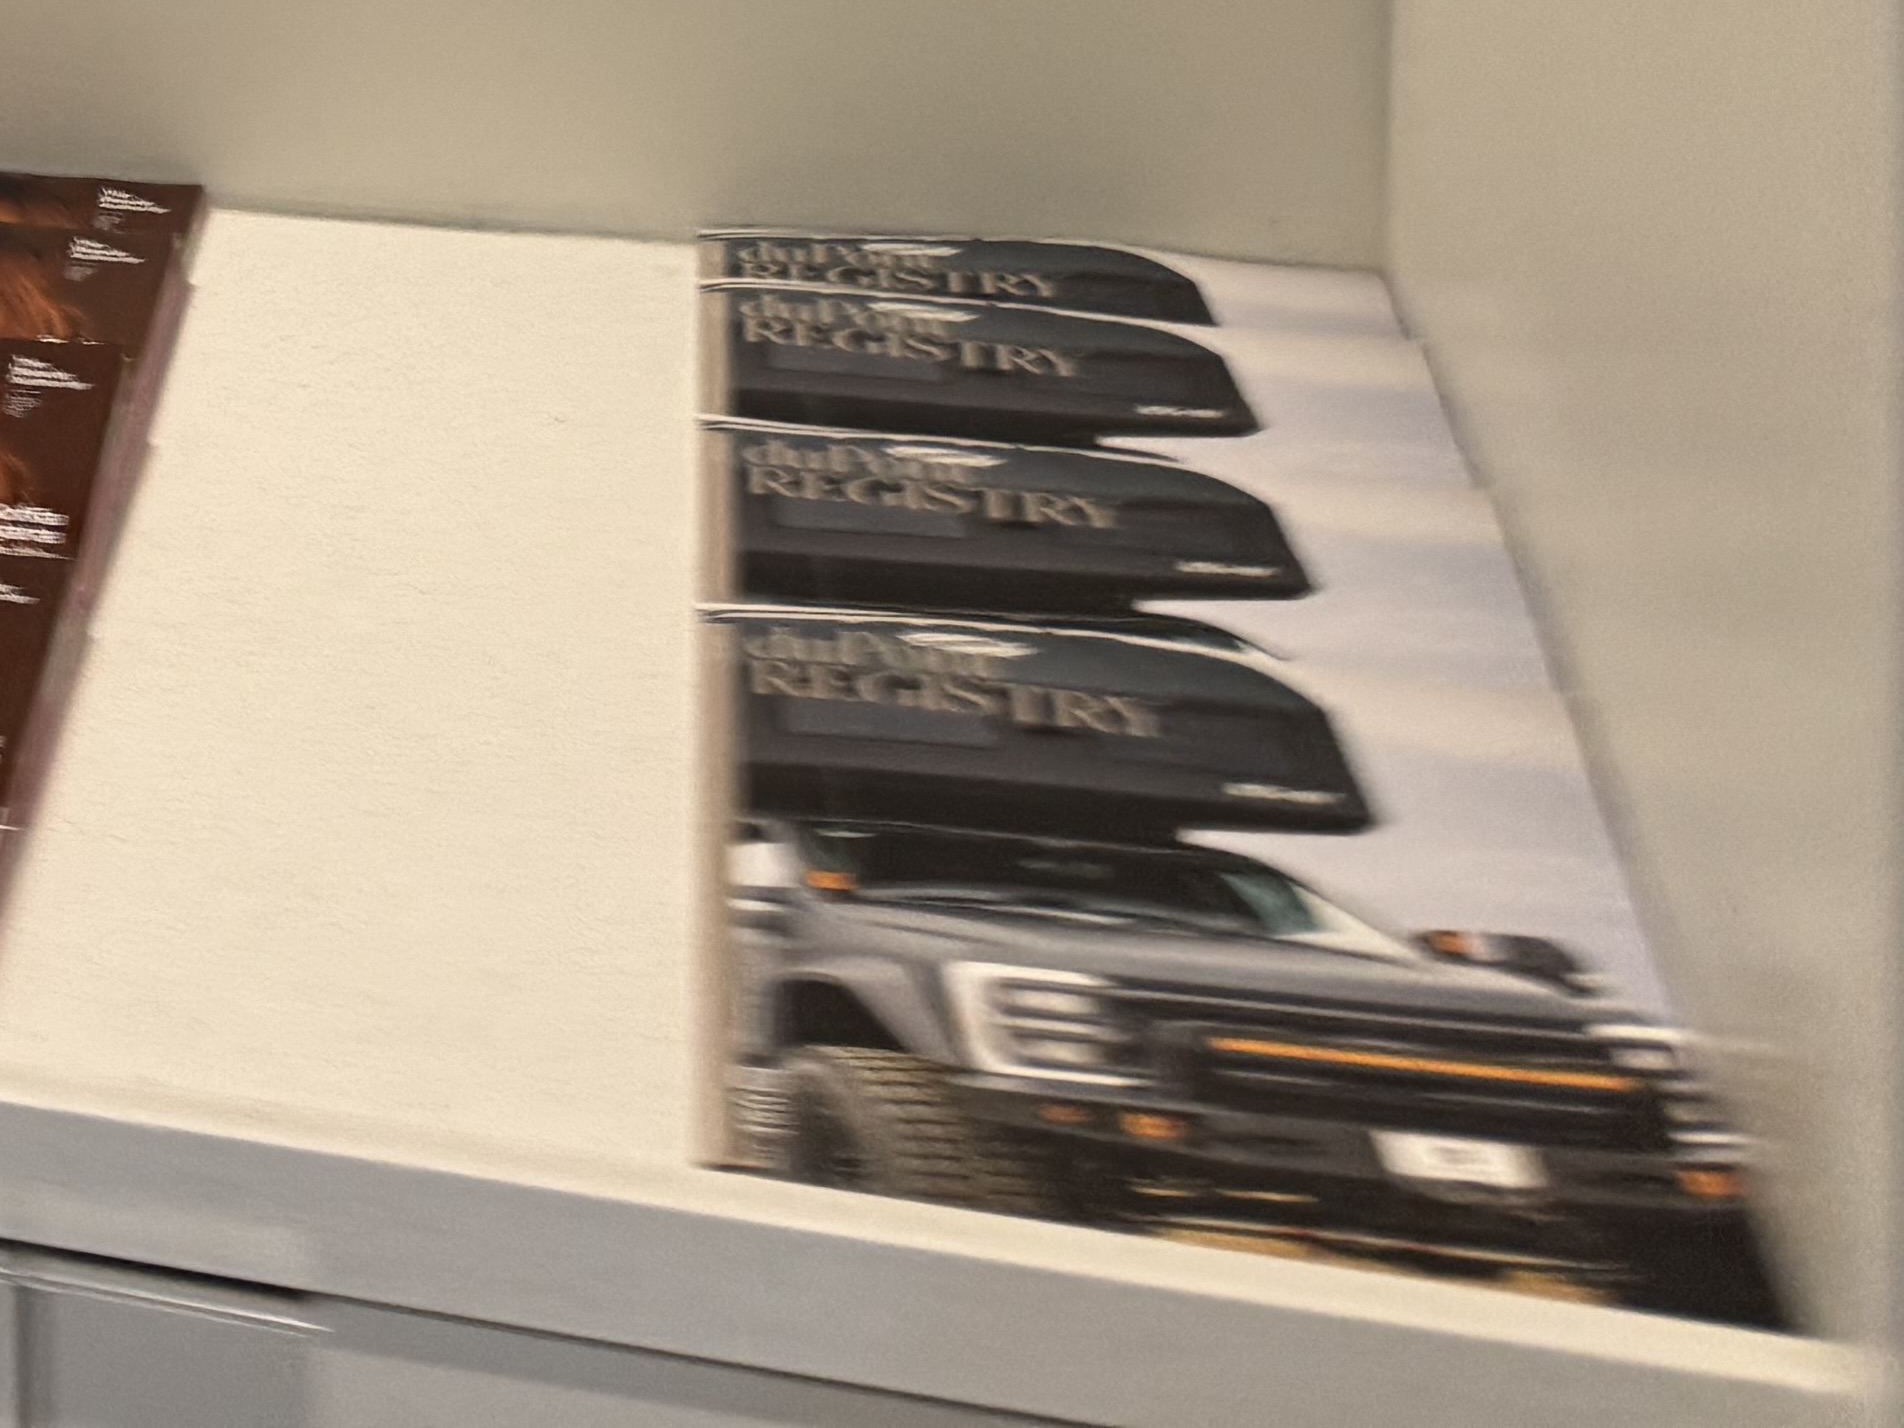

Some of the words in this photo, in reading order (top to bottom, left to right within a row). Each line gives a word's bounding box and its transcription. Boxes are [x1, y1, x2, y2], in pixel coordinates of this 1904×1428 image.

[745, 316, 1080, 379] REGISTRY
[747, 464, 1120, 529] REGISTRY
[747, 657, 1163, 739] REGISTRY
